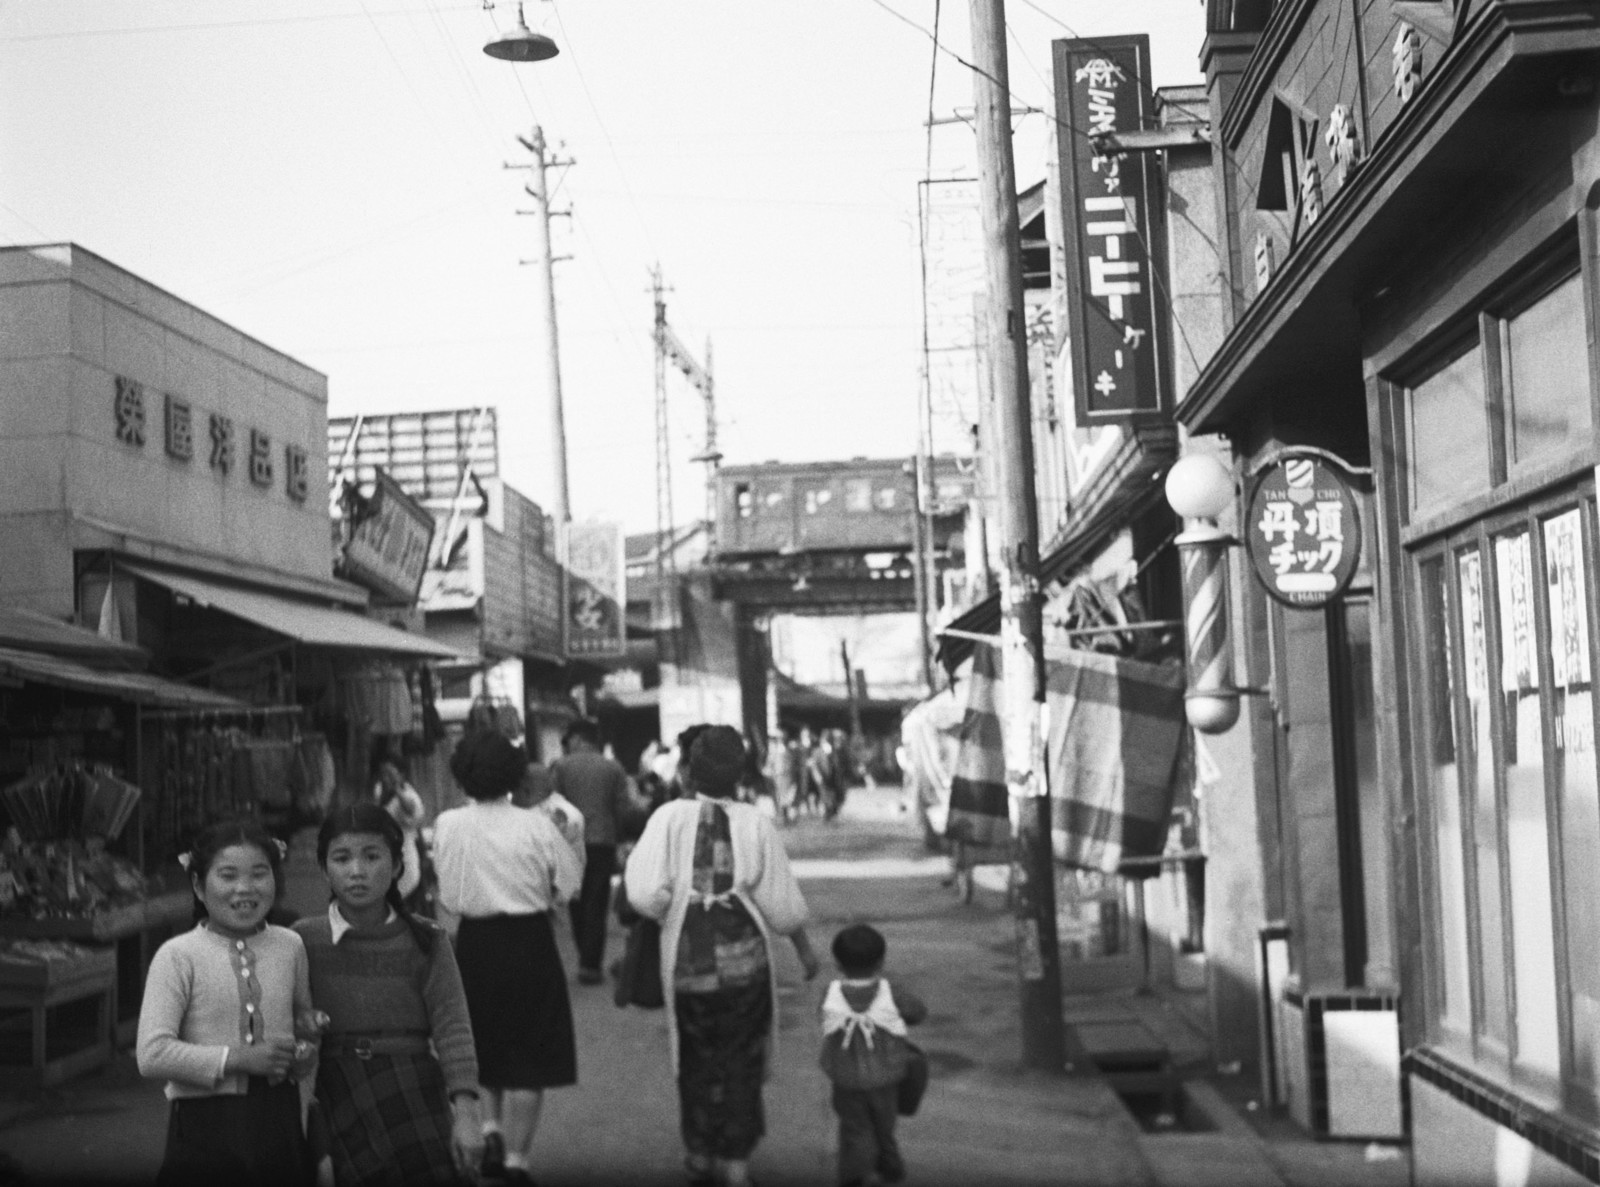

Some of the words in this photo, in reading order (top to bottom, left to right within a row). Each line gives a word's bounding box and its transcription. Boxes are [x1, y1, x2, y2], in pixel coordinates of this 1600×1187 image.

[1084, 195, 1142, 321] コーヒー
[1094, 323, 1146, 397] ケーキ
[1264, 490, 1286, 501] TAN
[1316, 489, 1341, 500] CHO
[1258, 501, 1344, 542] 丹頂
[1269, 541, 1343, 576] チック
[1289, 592, 1327, 603] CHAIN
